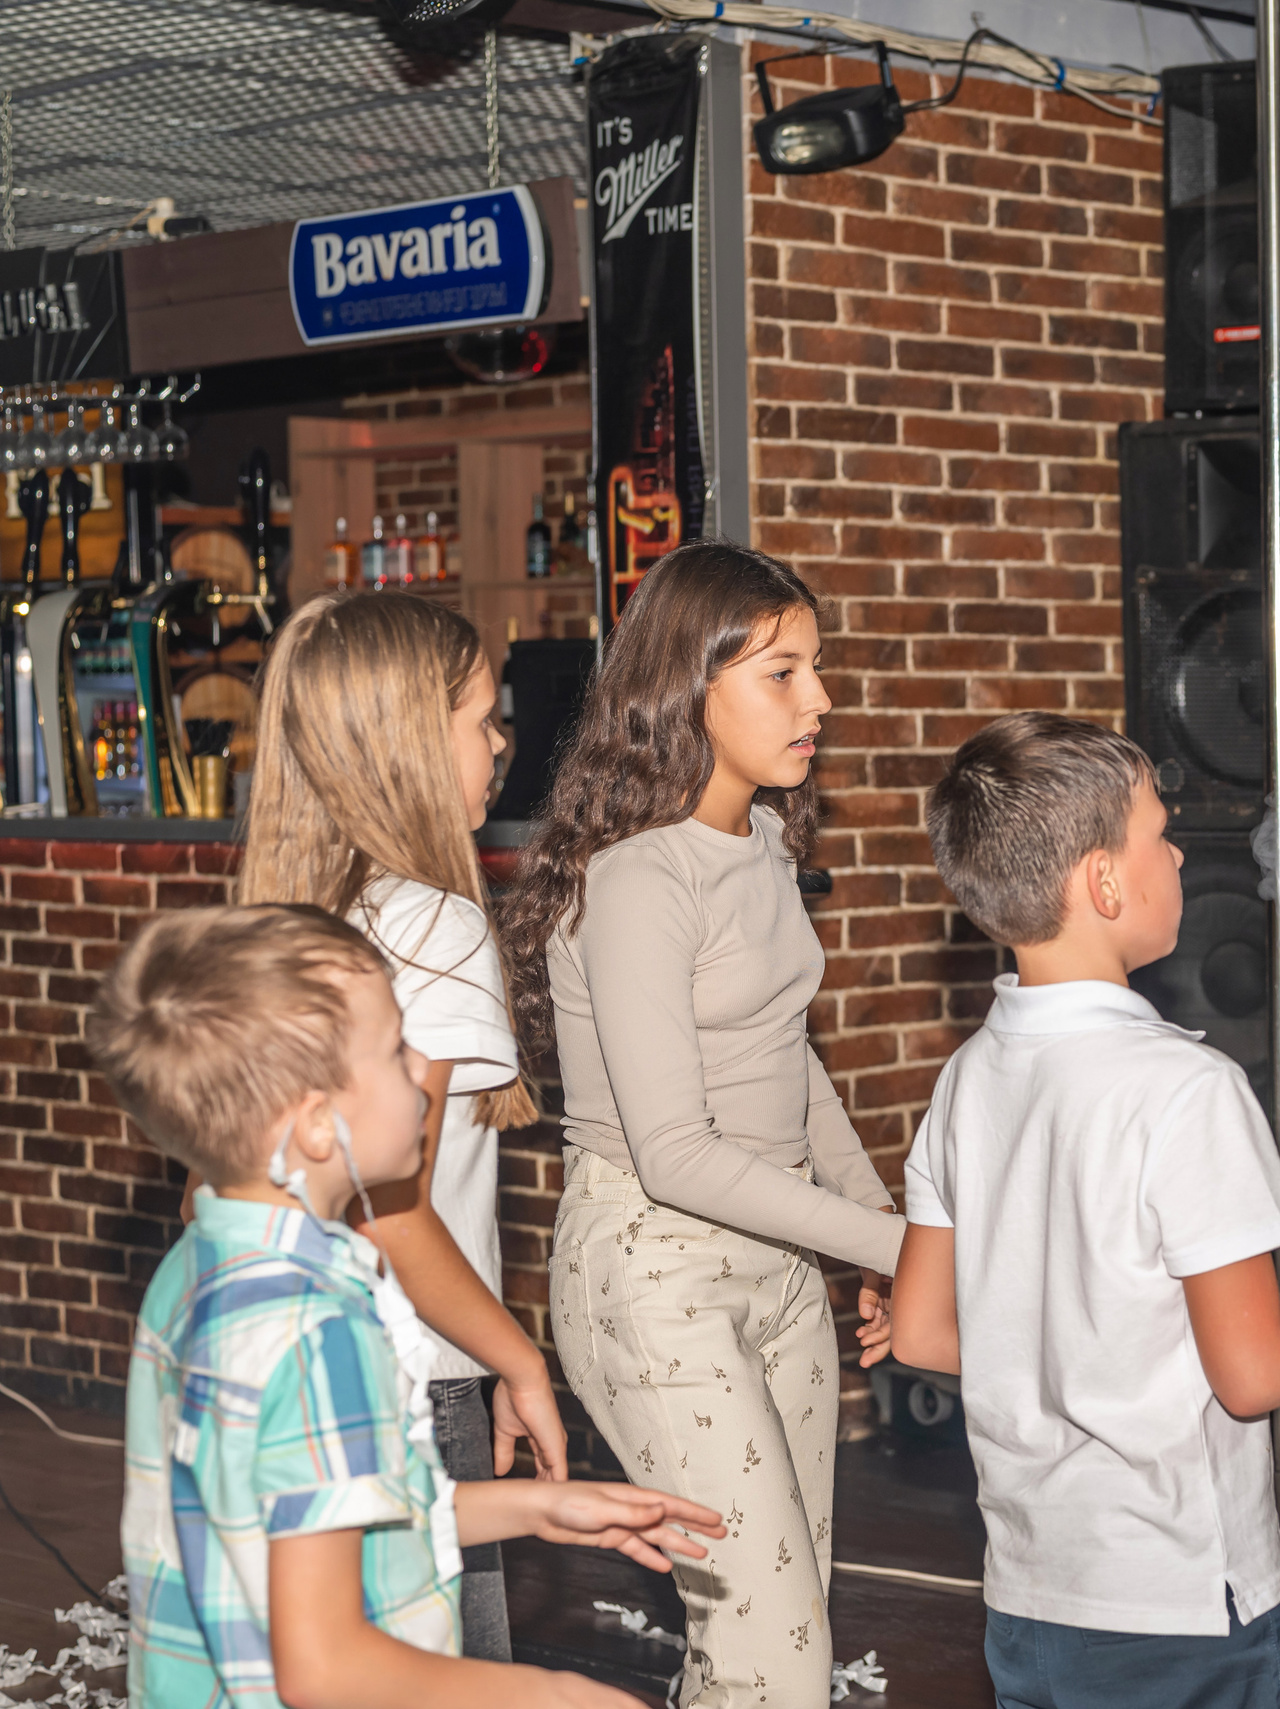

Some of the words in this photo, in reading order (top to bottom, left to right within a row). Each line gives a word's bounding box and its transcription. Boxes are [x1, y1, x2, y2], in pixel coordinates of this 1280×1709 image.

[597, 116, 633, 148] IT'S
[595, 135, 684, 242] Miller
[644, 203, 693, 235] TIME
[311, 204, 502, 298] Bavaria
